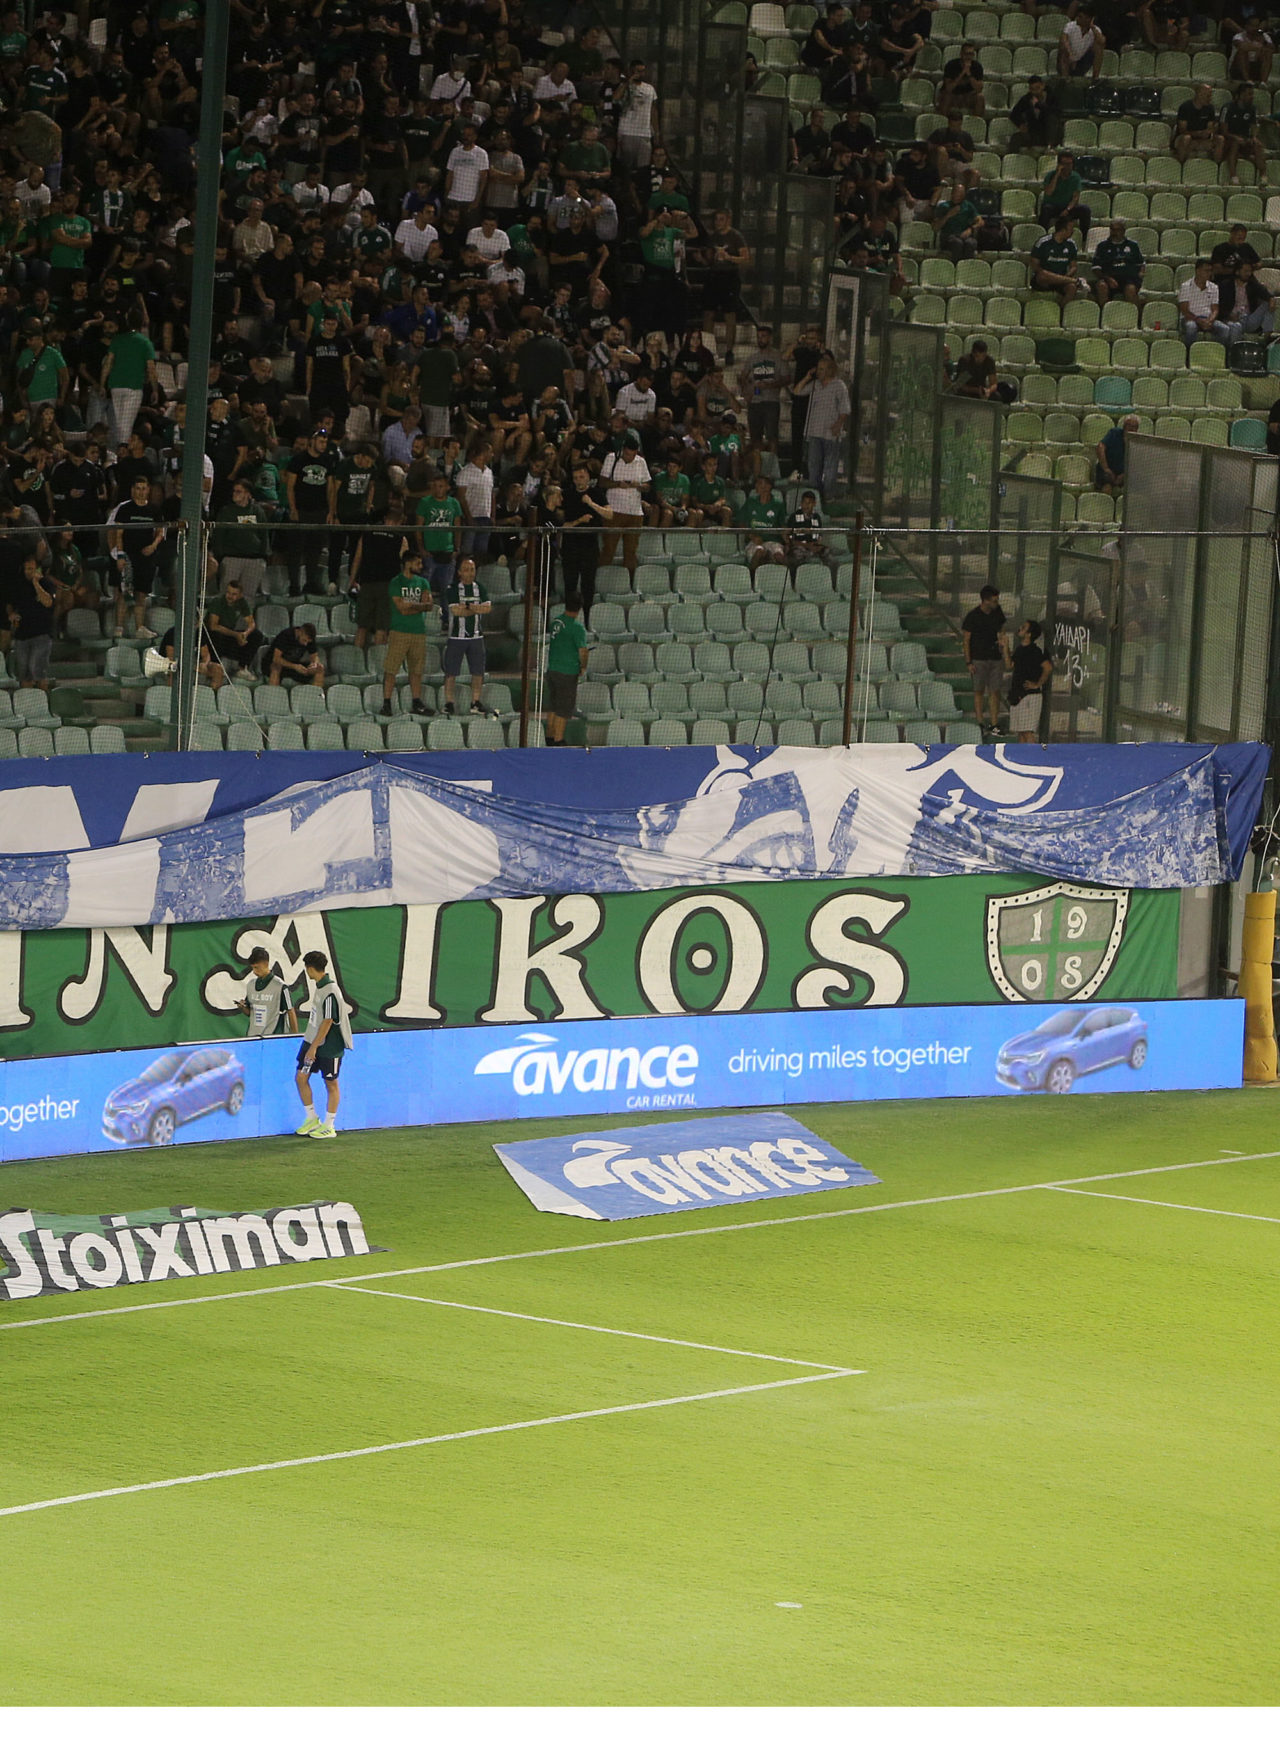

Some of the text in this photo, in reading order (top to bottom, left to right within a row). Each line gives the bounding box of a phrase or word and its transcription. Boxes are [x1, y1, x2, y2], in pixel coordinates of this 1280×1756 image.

[1030, 906, 1087, 942] 19
[512, 1044, 699, 1096] avance
[729, 1042, 972, 1078] driving miles together
[626, 1092, 697, 1109] CAR RENTAL
[611, 1138, 851, 1206] avance
